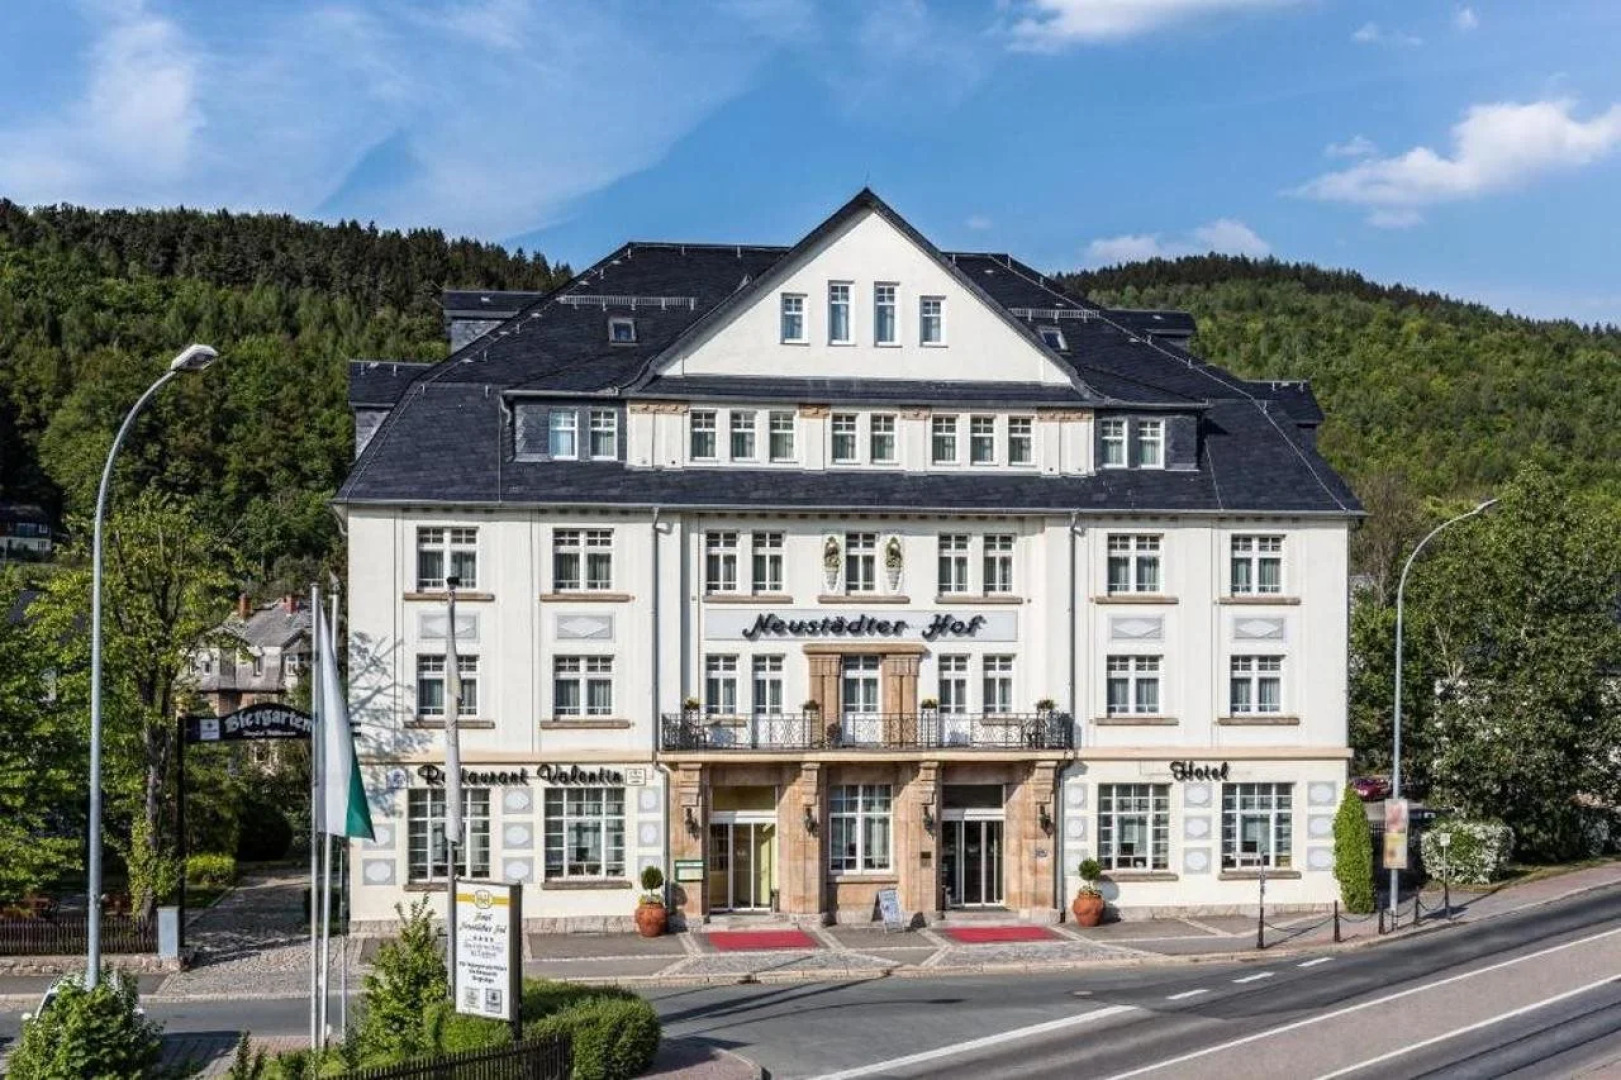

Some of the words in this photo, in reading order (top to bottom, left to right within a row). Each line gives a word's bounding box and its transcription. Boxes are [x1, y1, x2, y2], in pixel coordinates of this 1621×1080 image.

[742, 613, 908, 641] Neustädter
[922, 613, 987, 641] Hof
[224, 709, 314, 733] Biergarten
[418, 764, 528, 786] Rtaurant
[537, 763, 624, 786] Valentin
[1169, 760, 1229, 781] Hotel
